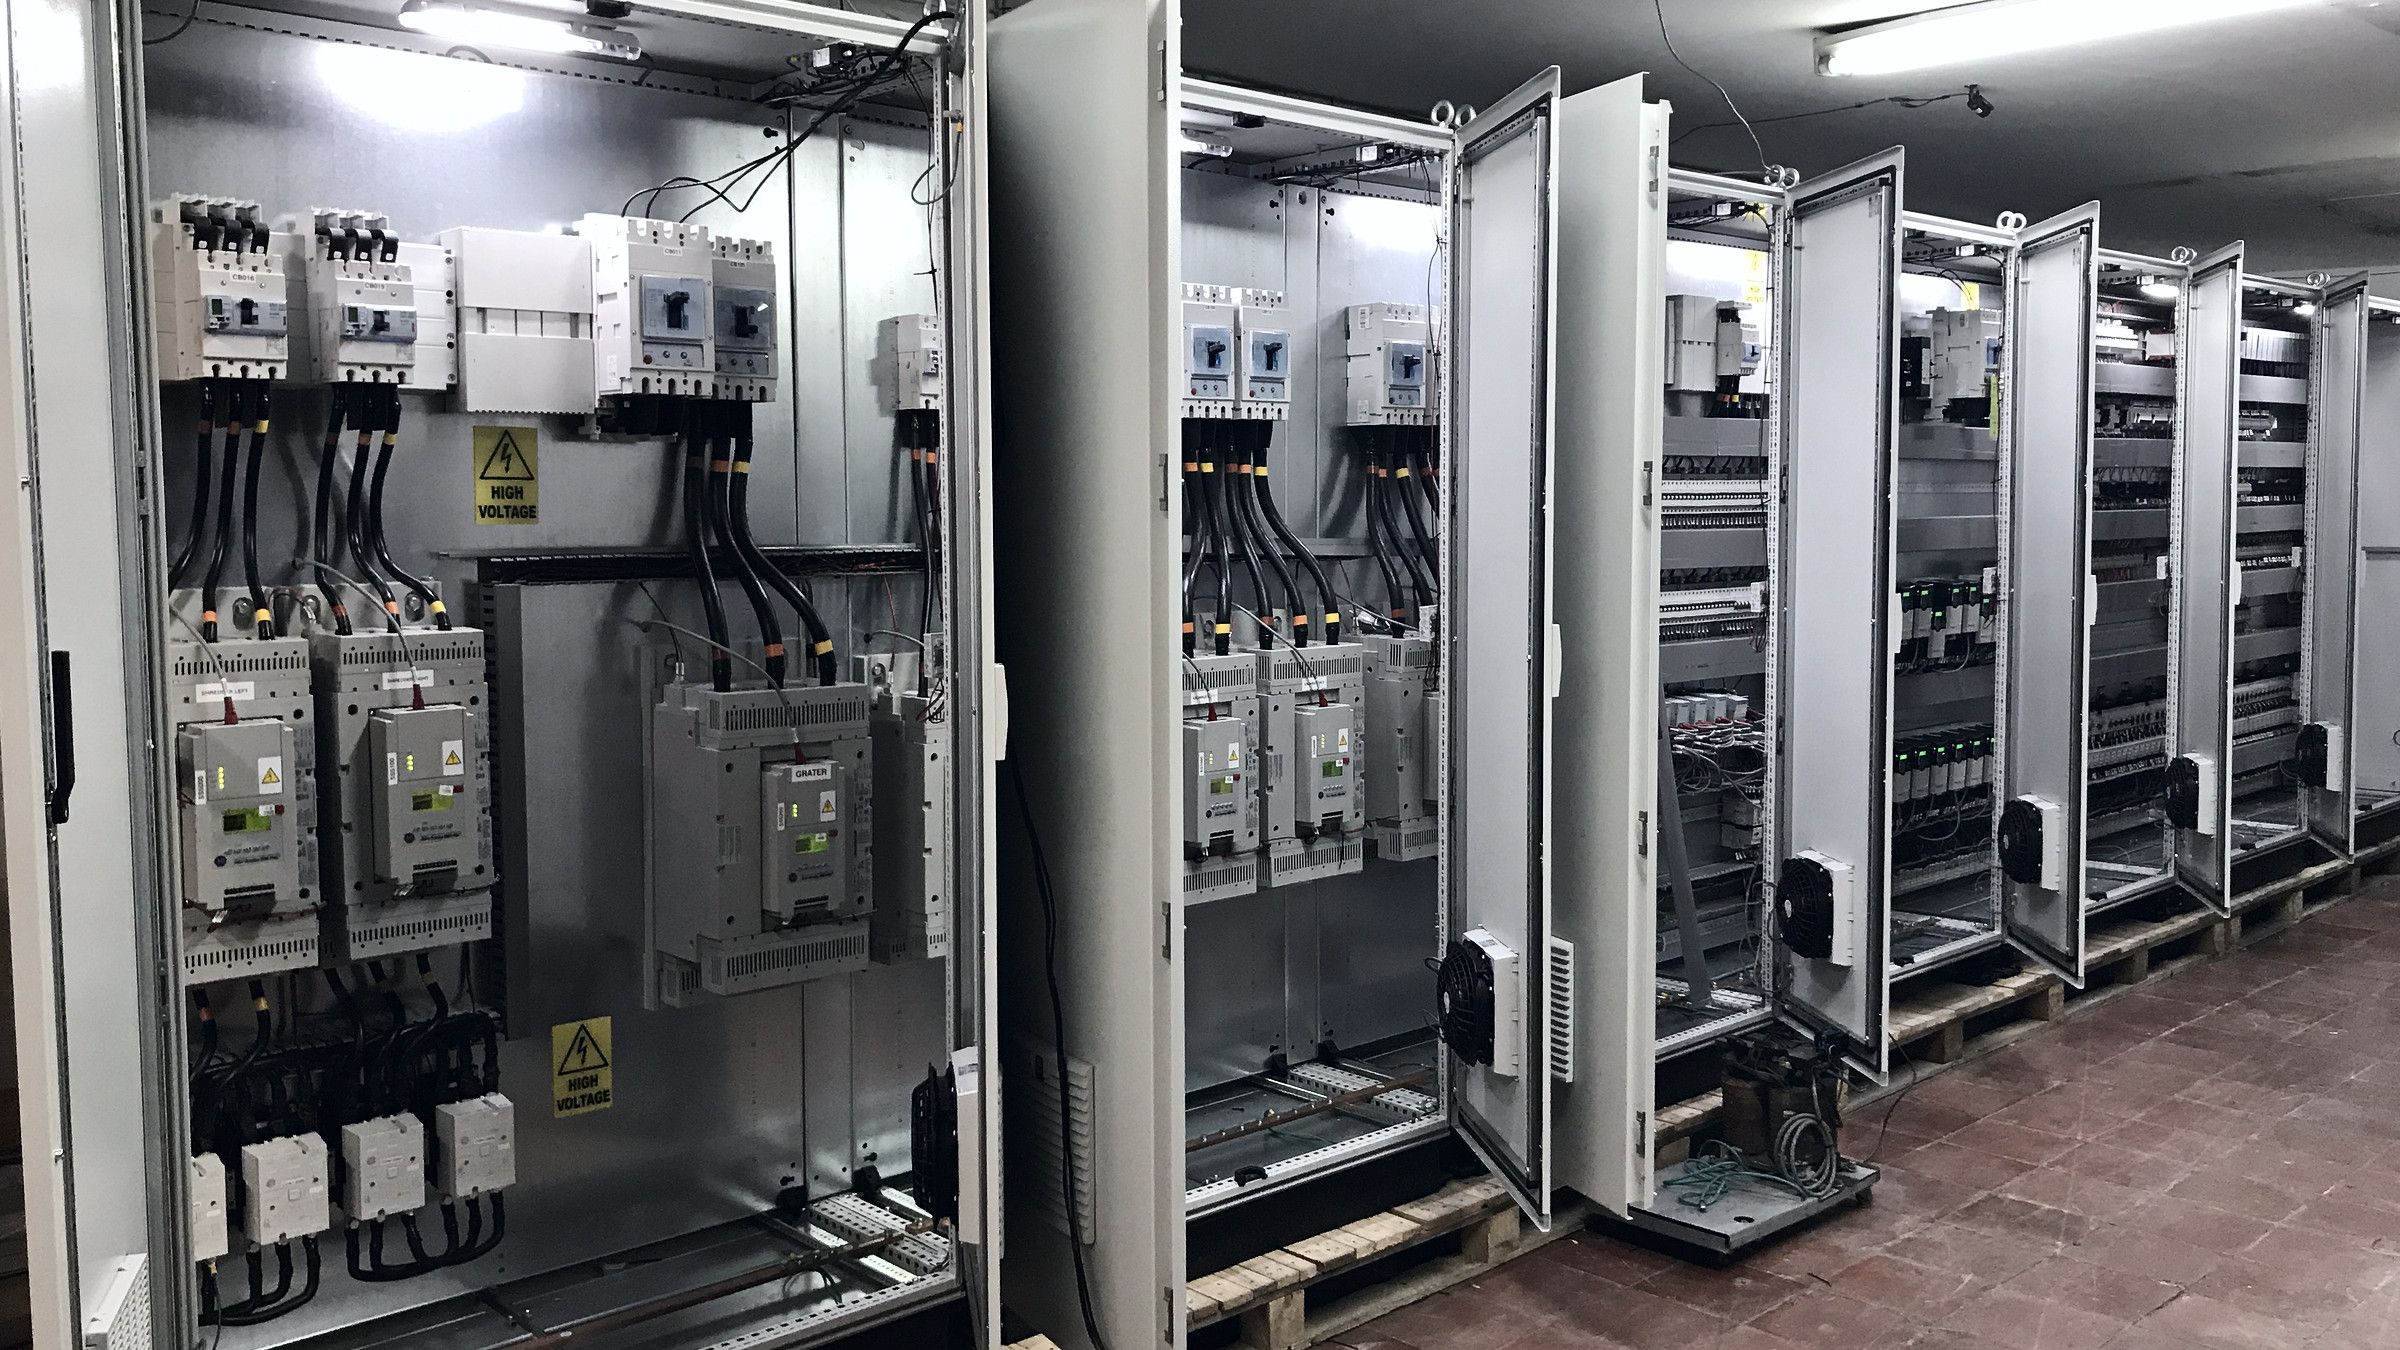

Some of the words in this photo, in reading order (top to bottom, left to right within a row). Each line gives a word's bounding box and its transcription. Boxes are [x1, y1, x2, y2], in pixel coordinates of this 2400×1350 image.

[491, 485, 524, 500] HIGH
[478, 504, 537, 519] VOLTAGE
[795, 768, 827, 778] GRATER
[568, 1073, 599, 1092] HIGH
[556, 1089, 611, 1111] VOLTAGE
